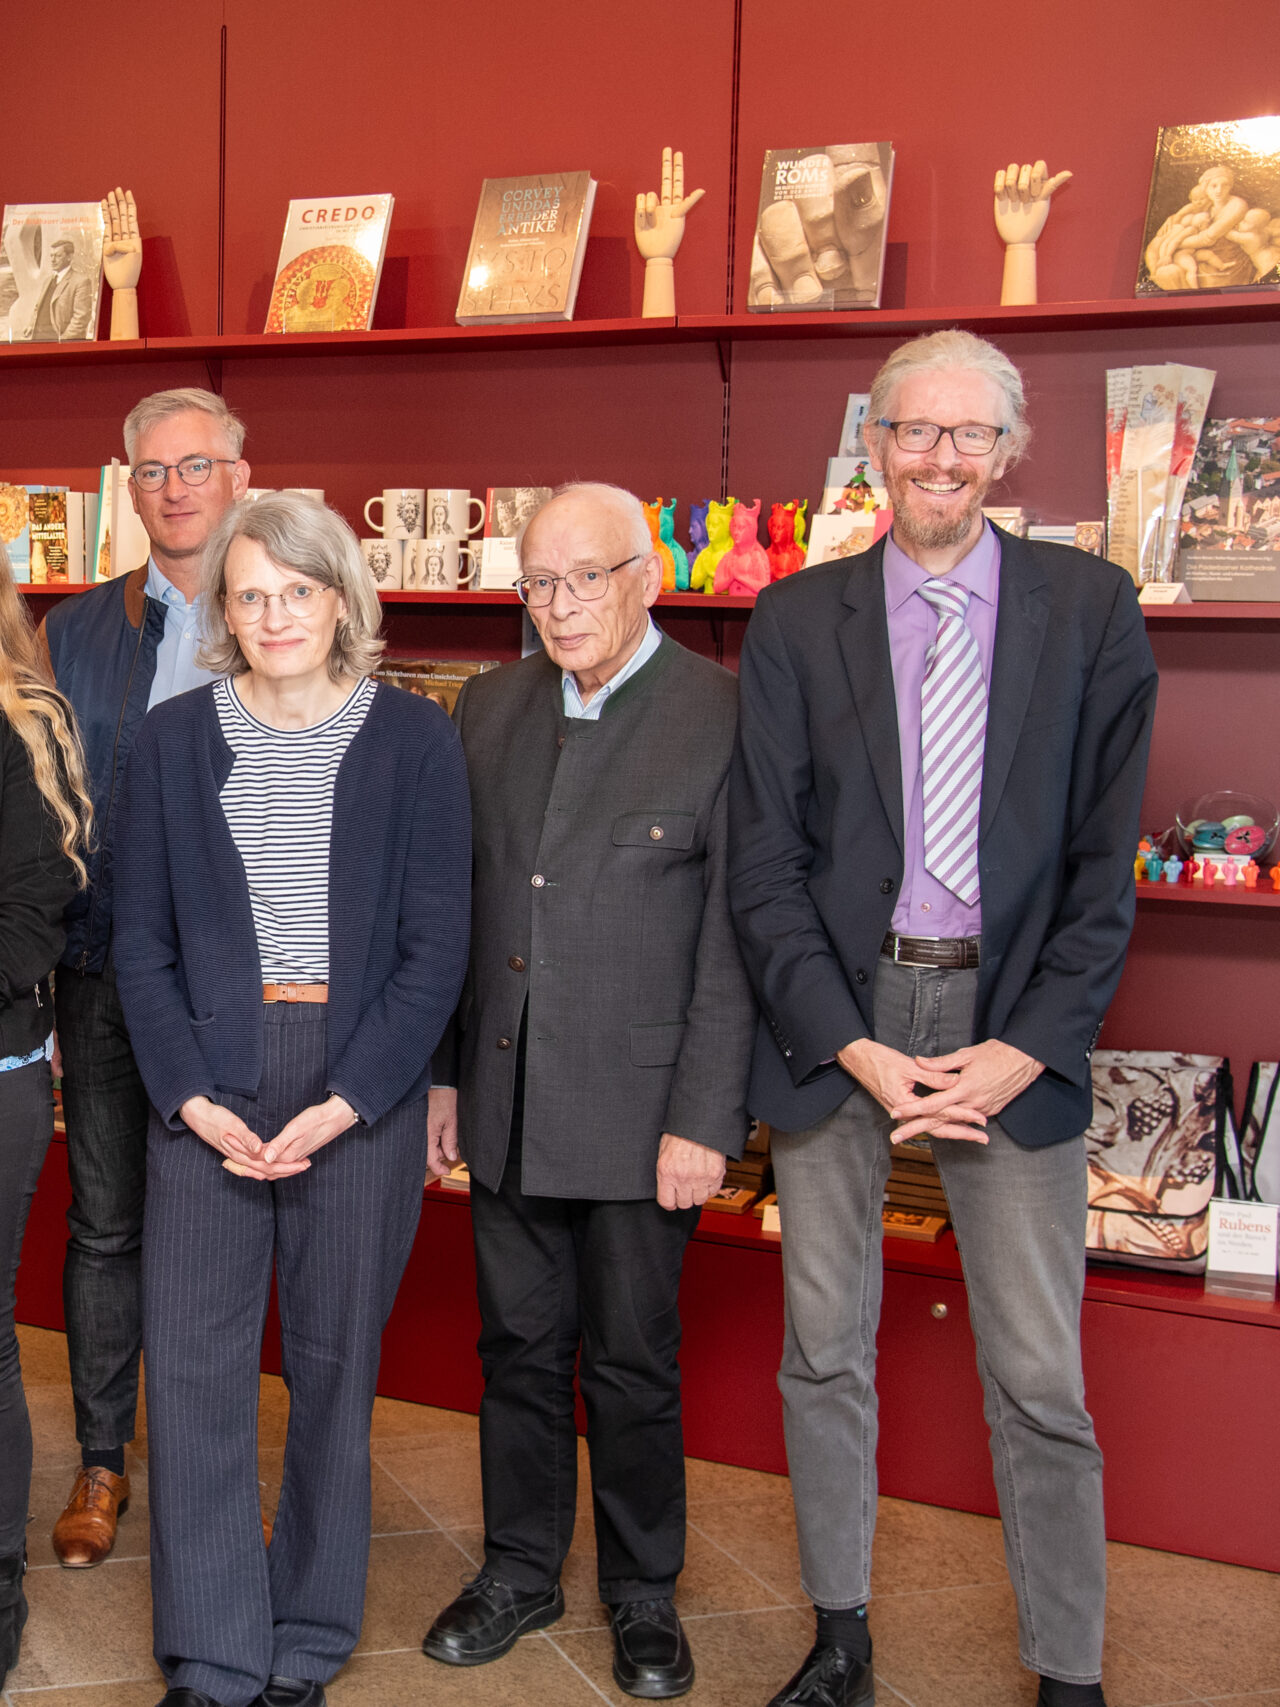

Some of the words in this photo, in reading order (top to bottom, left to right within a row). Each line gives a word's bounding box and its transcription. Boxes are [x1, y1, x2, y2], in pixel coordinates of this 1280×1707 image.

[503, 186, 563, 202] CORVEY
[301, 206, 375, 223] CREDO
[497, 219, 557, 236] ANTIKE
[1219, 1217, 1272, 1233] Rubens
